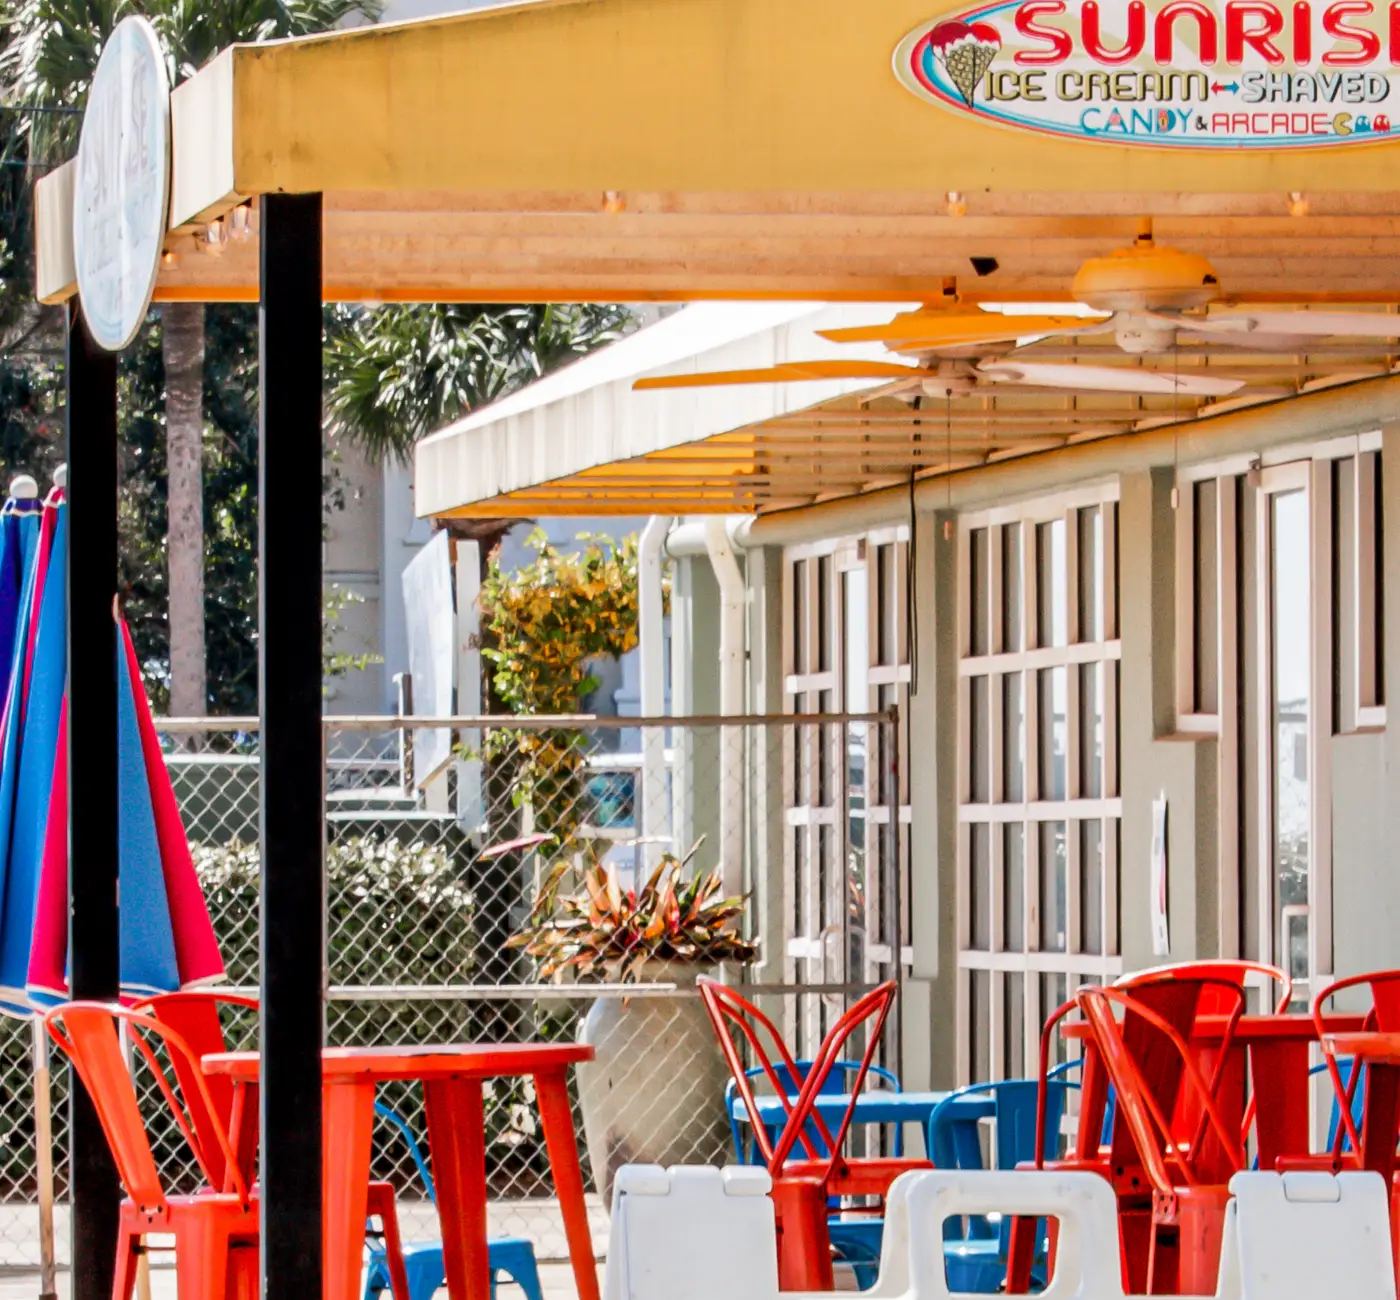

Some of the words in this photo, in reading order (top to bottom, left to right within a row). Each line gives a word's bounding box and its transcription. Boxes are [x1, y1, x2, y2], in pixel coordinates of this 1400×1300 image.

[1013, 0, 1400, 67] SUNRIS
[984, 70, 1047, 101] ICE
[1055, 70, 1209, 101] CREAM
[1242, 72, 1390, 103] SHAVED
[1080, 107, 1193, 134] CANDY
[1195, 116, 1208, 131] &
[1212, 112, 1329, 134] ARCADE
